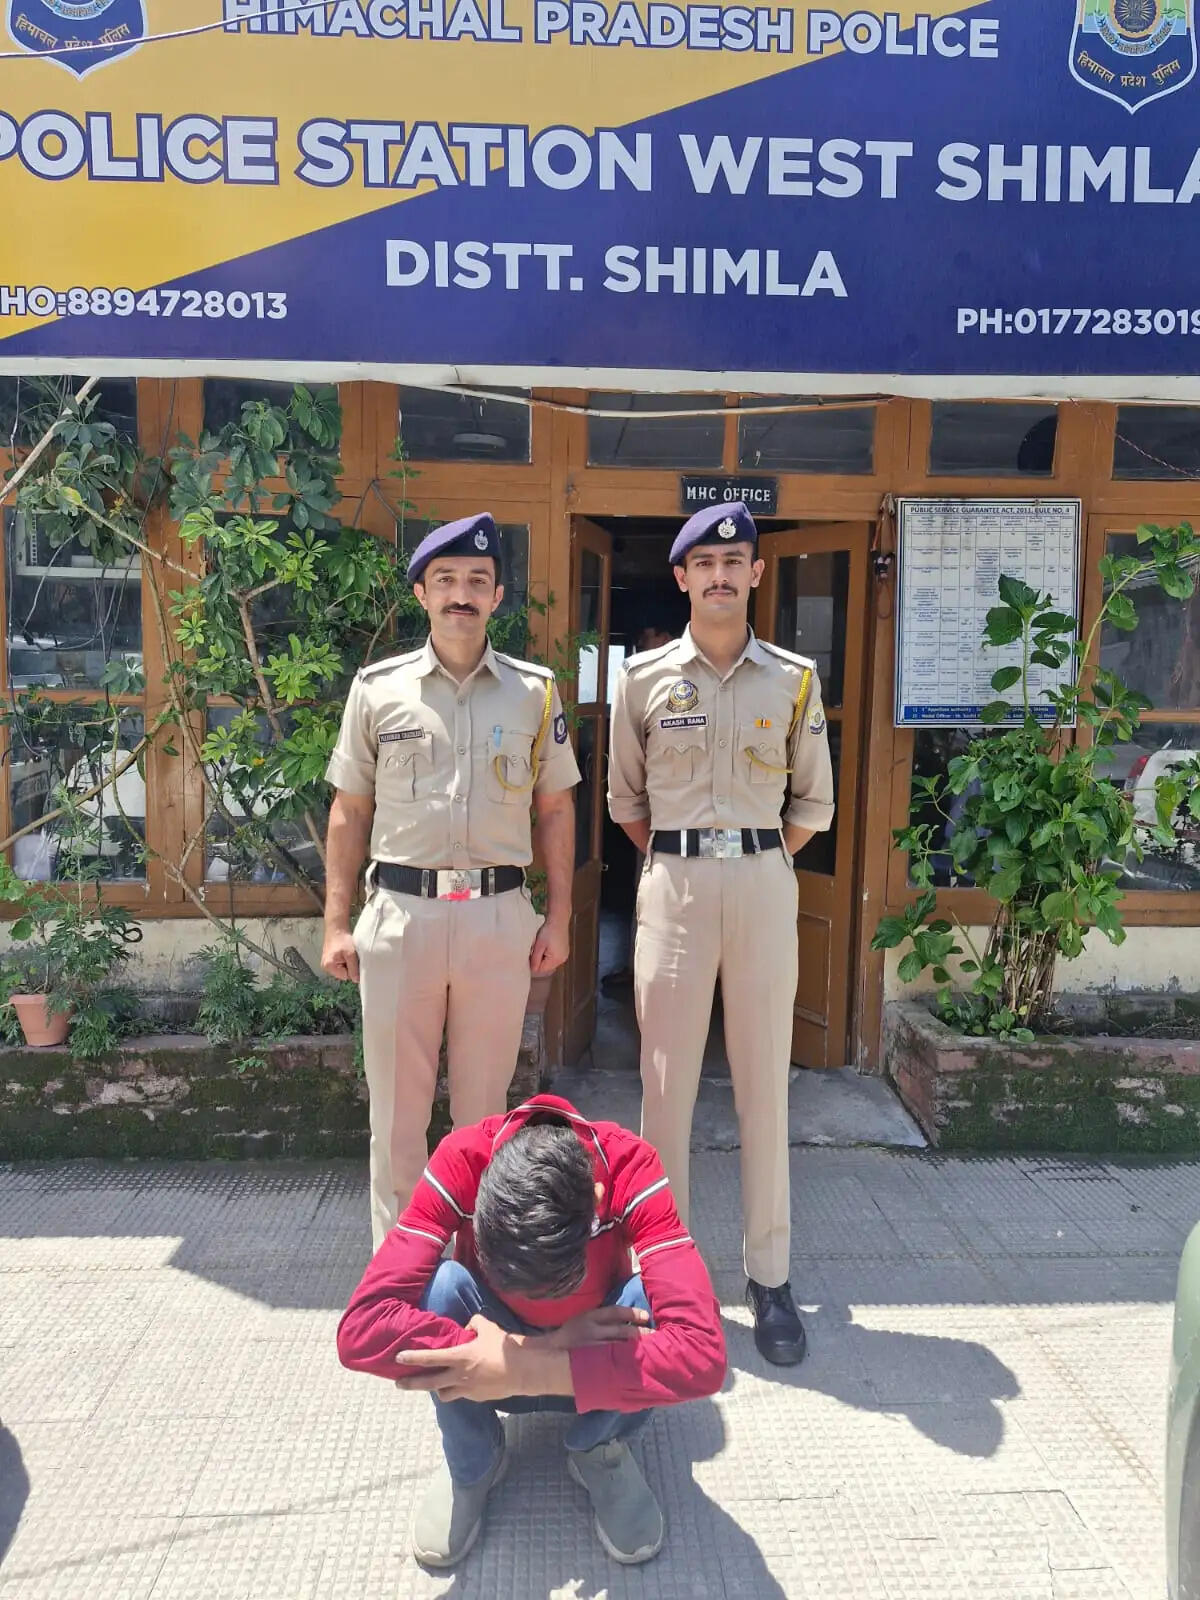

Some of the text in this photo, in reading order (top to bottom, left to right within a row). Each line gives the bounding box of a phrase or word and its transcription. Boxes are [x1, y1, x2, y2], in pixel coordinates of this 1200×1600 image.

[15, 13, 58, 49] हिमाचल
[223, 0, 999, 58] HIMACHAL PRADESH POLICE
[1077, 50, 1181, 87] हिमाचल प्रदेश पुलिस
[295, 118, 652, 192] STATION
[679, 134, 913, 199] WEST
[386, 239, 848, 297] DISTT. SHIMLA
[687, 486, 771, 502] MHC OFFICE
[663, 717, 705, 728] AKASH RANA
